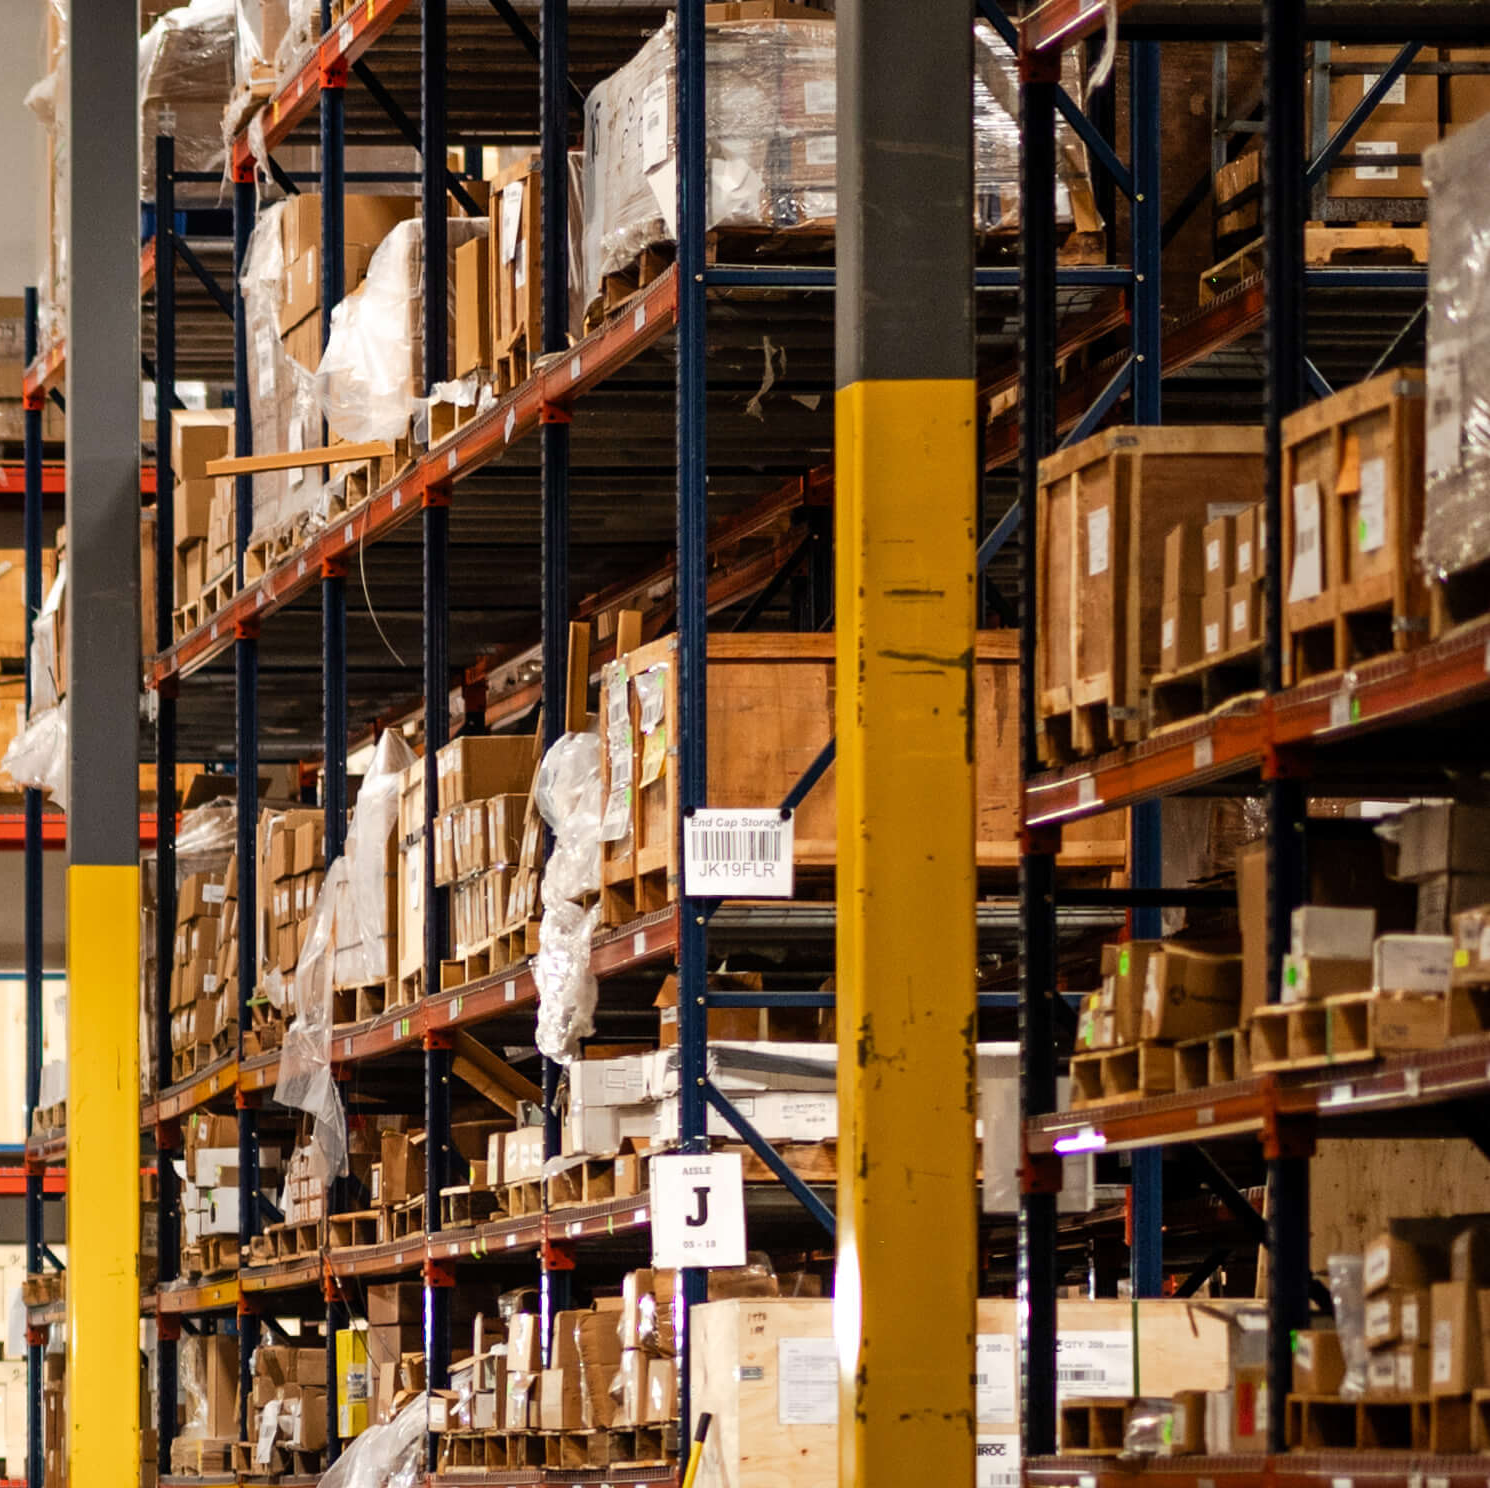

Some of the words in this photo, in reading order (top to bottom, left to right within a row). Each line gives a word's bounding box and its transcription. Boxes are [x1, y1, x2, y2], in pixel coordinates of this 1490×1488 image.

[691, 817, 712, 827] End
[715, 817, 737, 829] Cap
[740, 817, 782, 829] Storage
[699, 862, 776, 877] JK19FLR
[682, 1166, 712, 1175] AISLE
[685, 1186, 711, 1228] J
